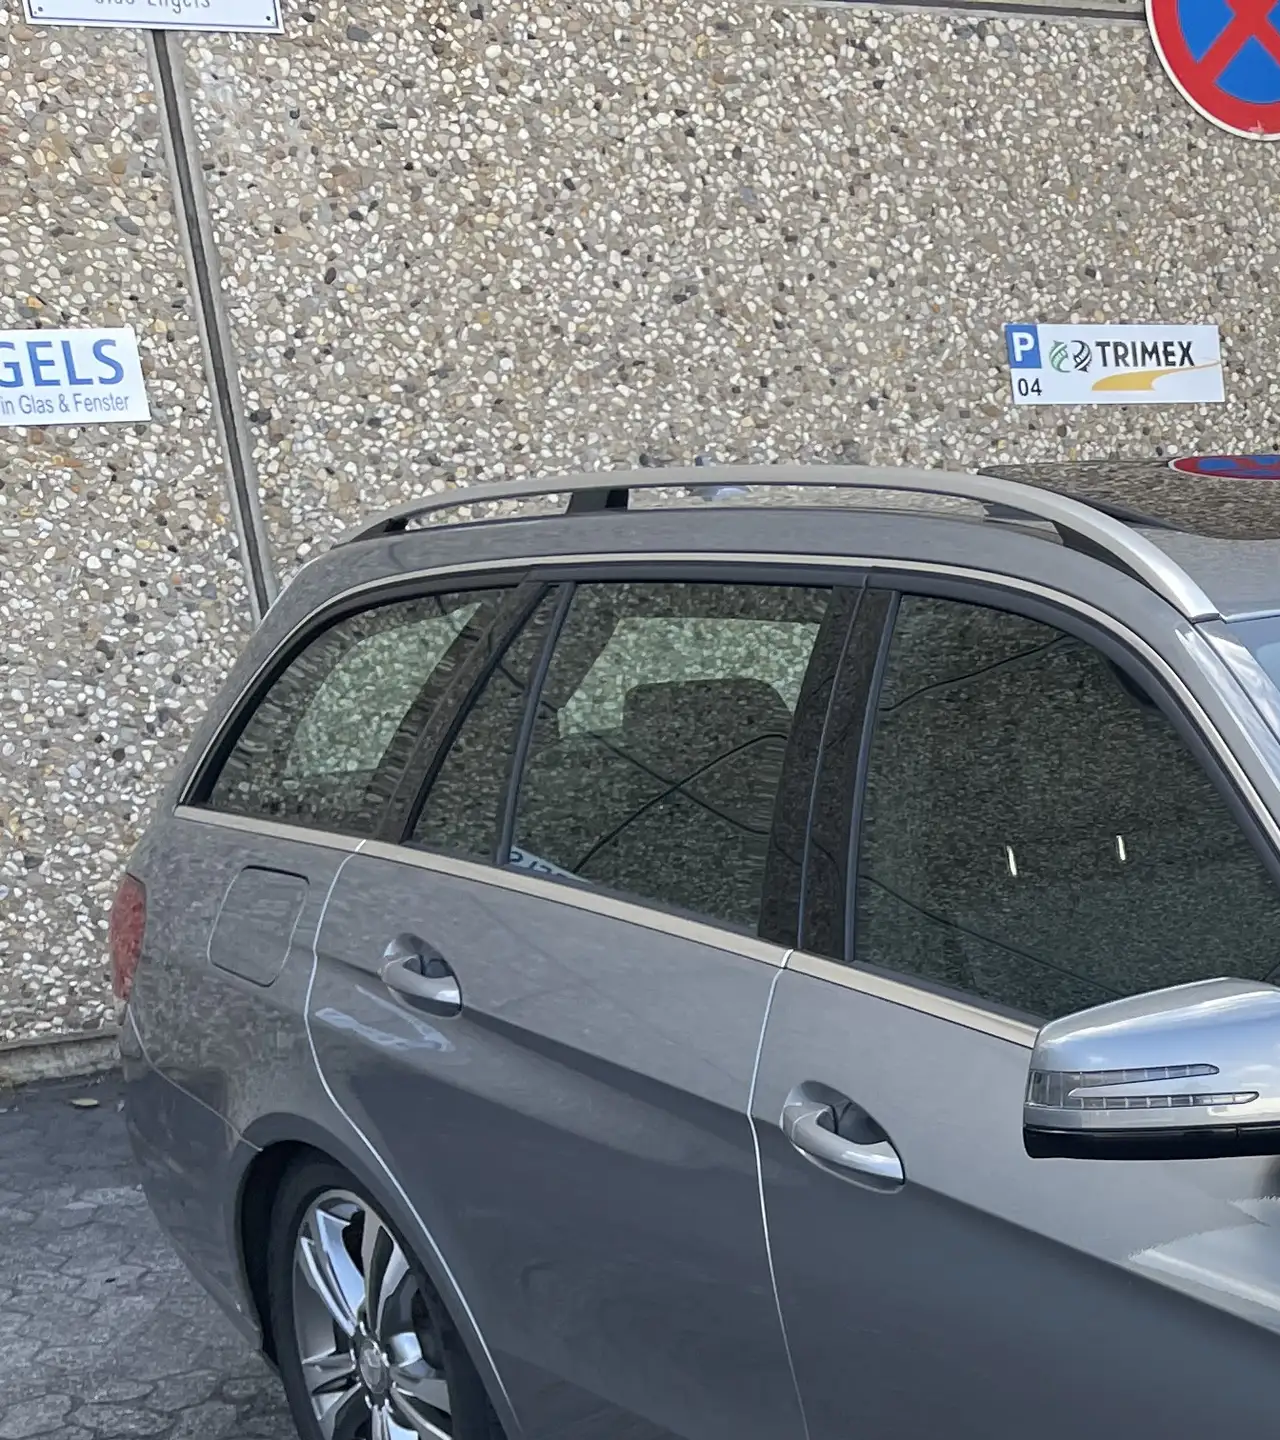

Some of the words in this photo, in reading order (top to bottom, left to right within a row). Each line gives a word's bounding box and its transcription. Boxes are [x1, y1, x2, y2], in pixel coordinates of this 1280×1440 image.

[1012, 332, 1035, 362] P
[1095, 341, 1195, 368] TRIMEX
[1018, 378, 1042, 396] 04
[19, 394, 54, 414] Glas
[58, 393, 70, 413] &
[73, 392, 129, 412] Fenster
